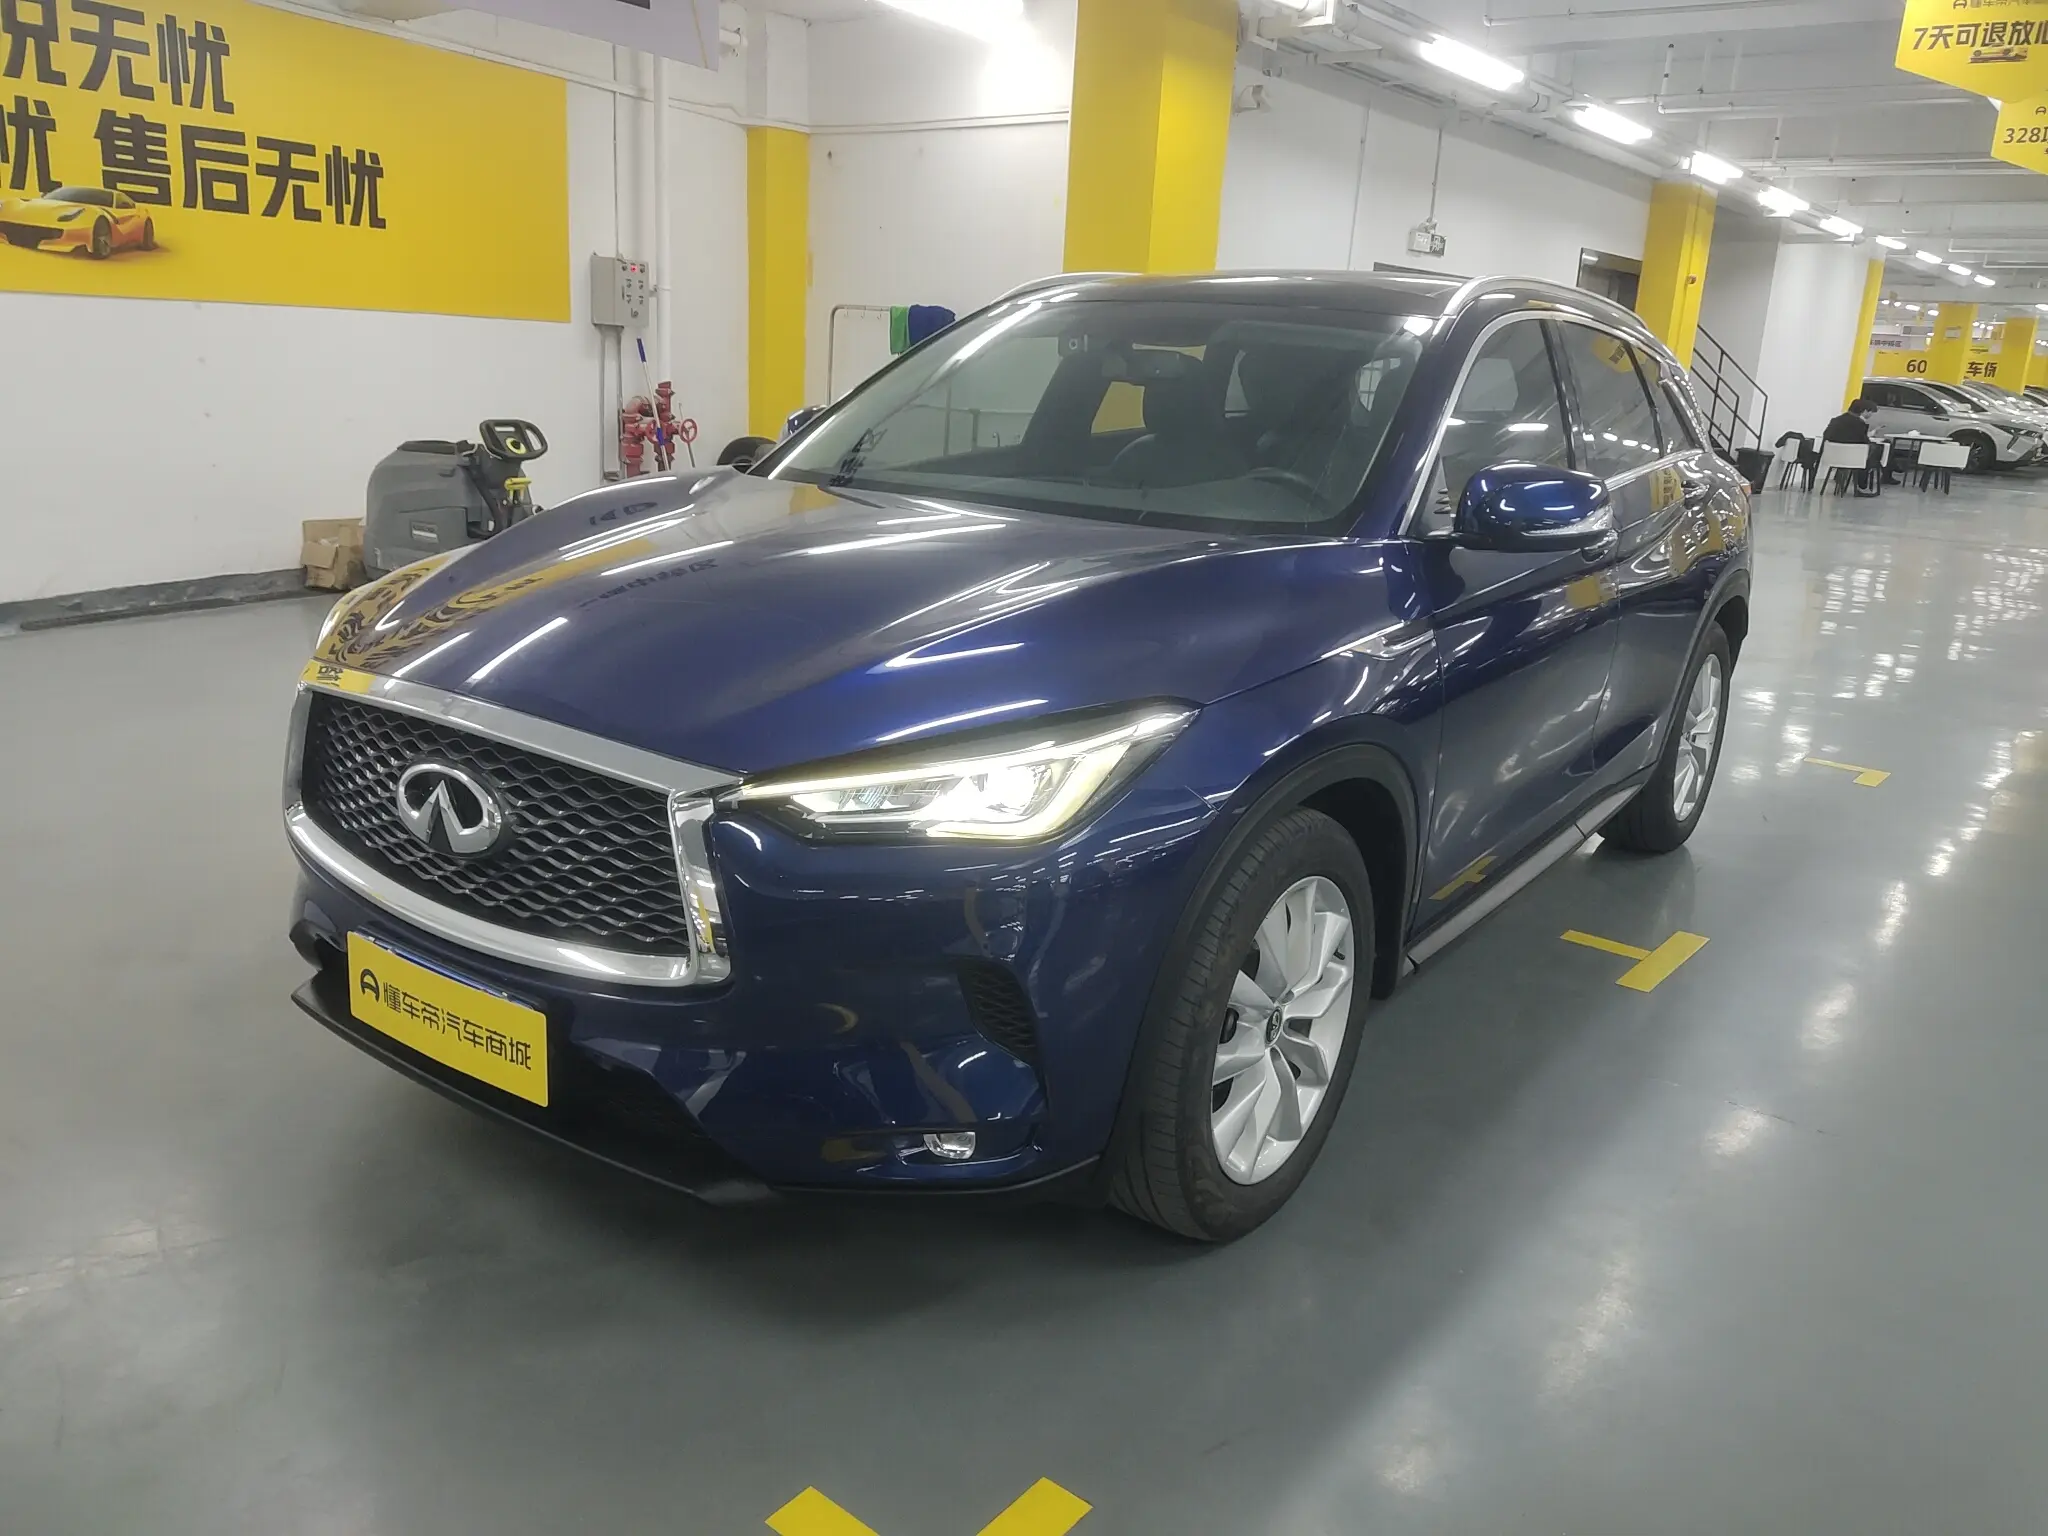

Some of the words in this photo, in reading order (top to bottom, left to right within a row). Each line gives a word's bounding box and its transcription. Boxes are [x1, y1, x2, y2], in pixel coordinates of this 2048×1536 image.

[93, 108, 388, 230] 售后无忧
[1906, 359, 1928, 374] 60
[383, 981, 532, 1071] 懂车帝汽车商城
